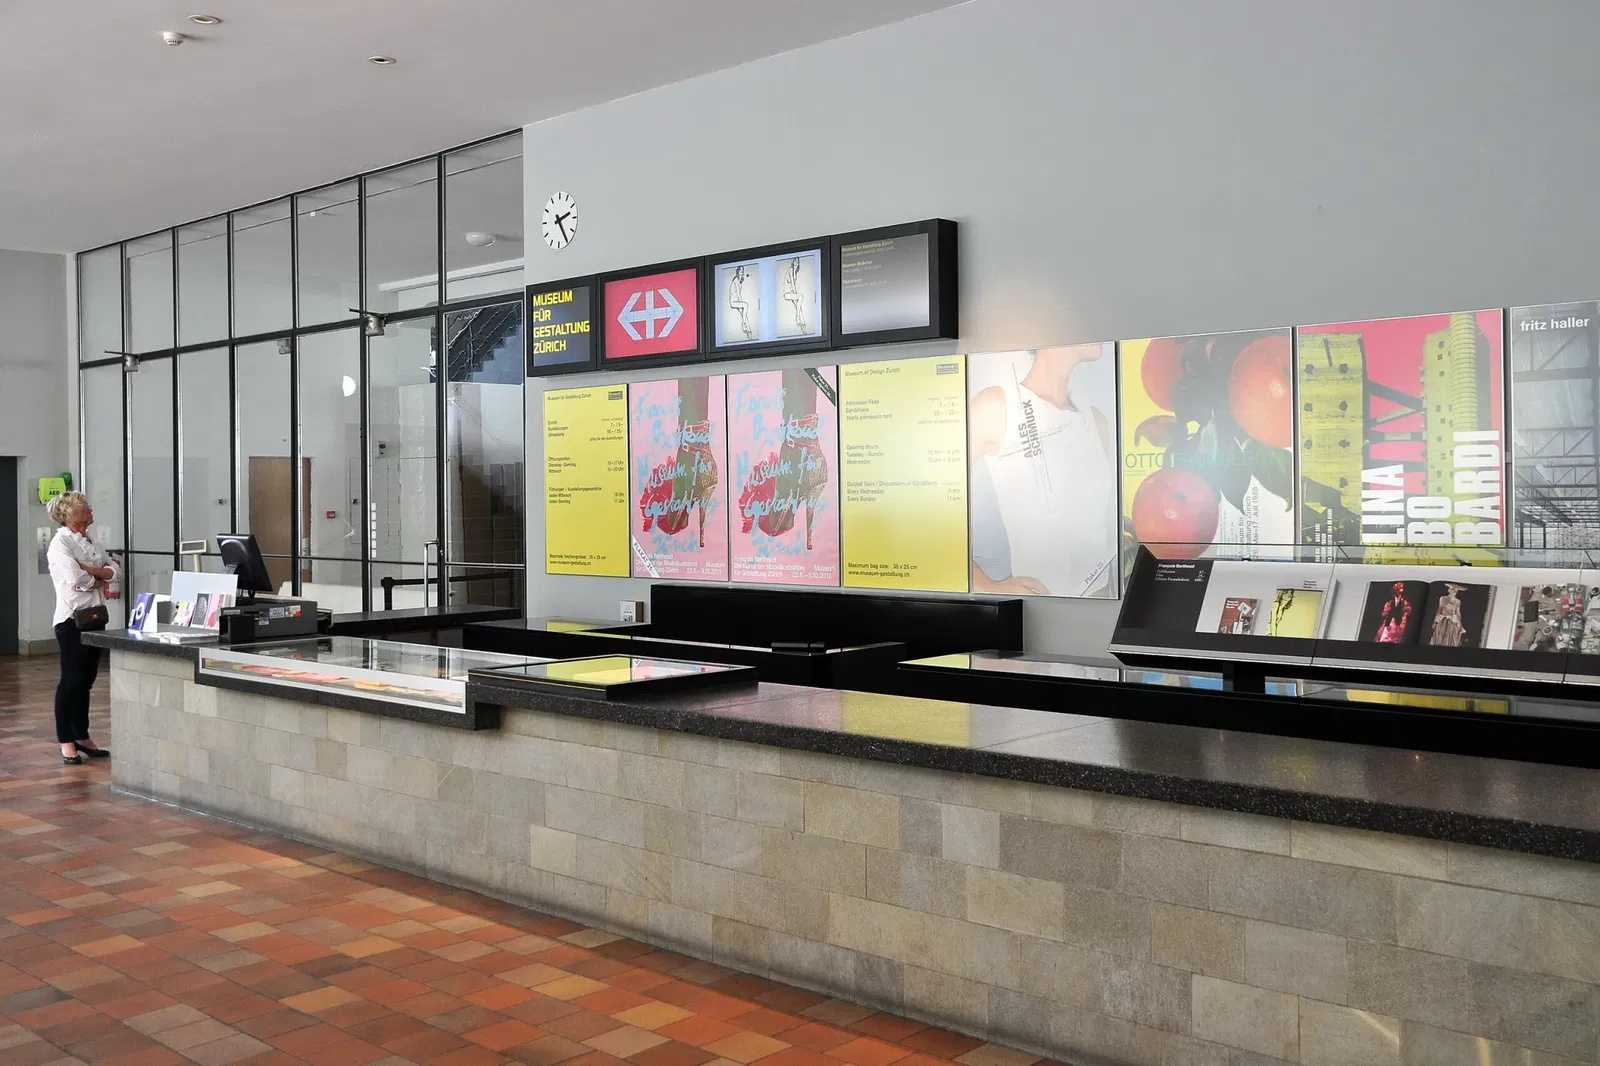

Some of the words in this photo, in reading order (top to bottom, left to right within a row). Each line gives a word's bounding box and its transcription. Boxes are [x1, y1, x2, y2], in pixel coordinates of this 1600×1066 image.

[533, 290, 572, 306] MUSEUM
[533, 308, 551, 322] FÜR
[1520, 320, 1547, 331] fritz
[1551, 317, 1589, 329] haller
[534, 321, 590, 338] GESTALTUNG
[533, 340, 566, 354] ZÜRICH
[1018, 422, 1033, 458] ALLES
[1023, 399, 1042, 456] SCHMUCK
[1453, 430, 1500, 544] BARDI
[1362, 464, 1404, 543] LINA
[1407, 496, 1451, 544] BO
